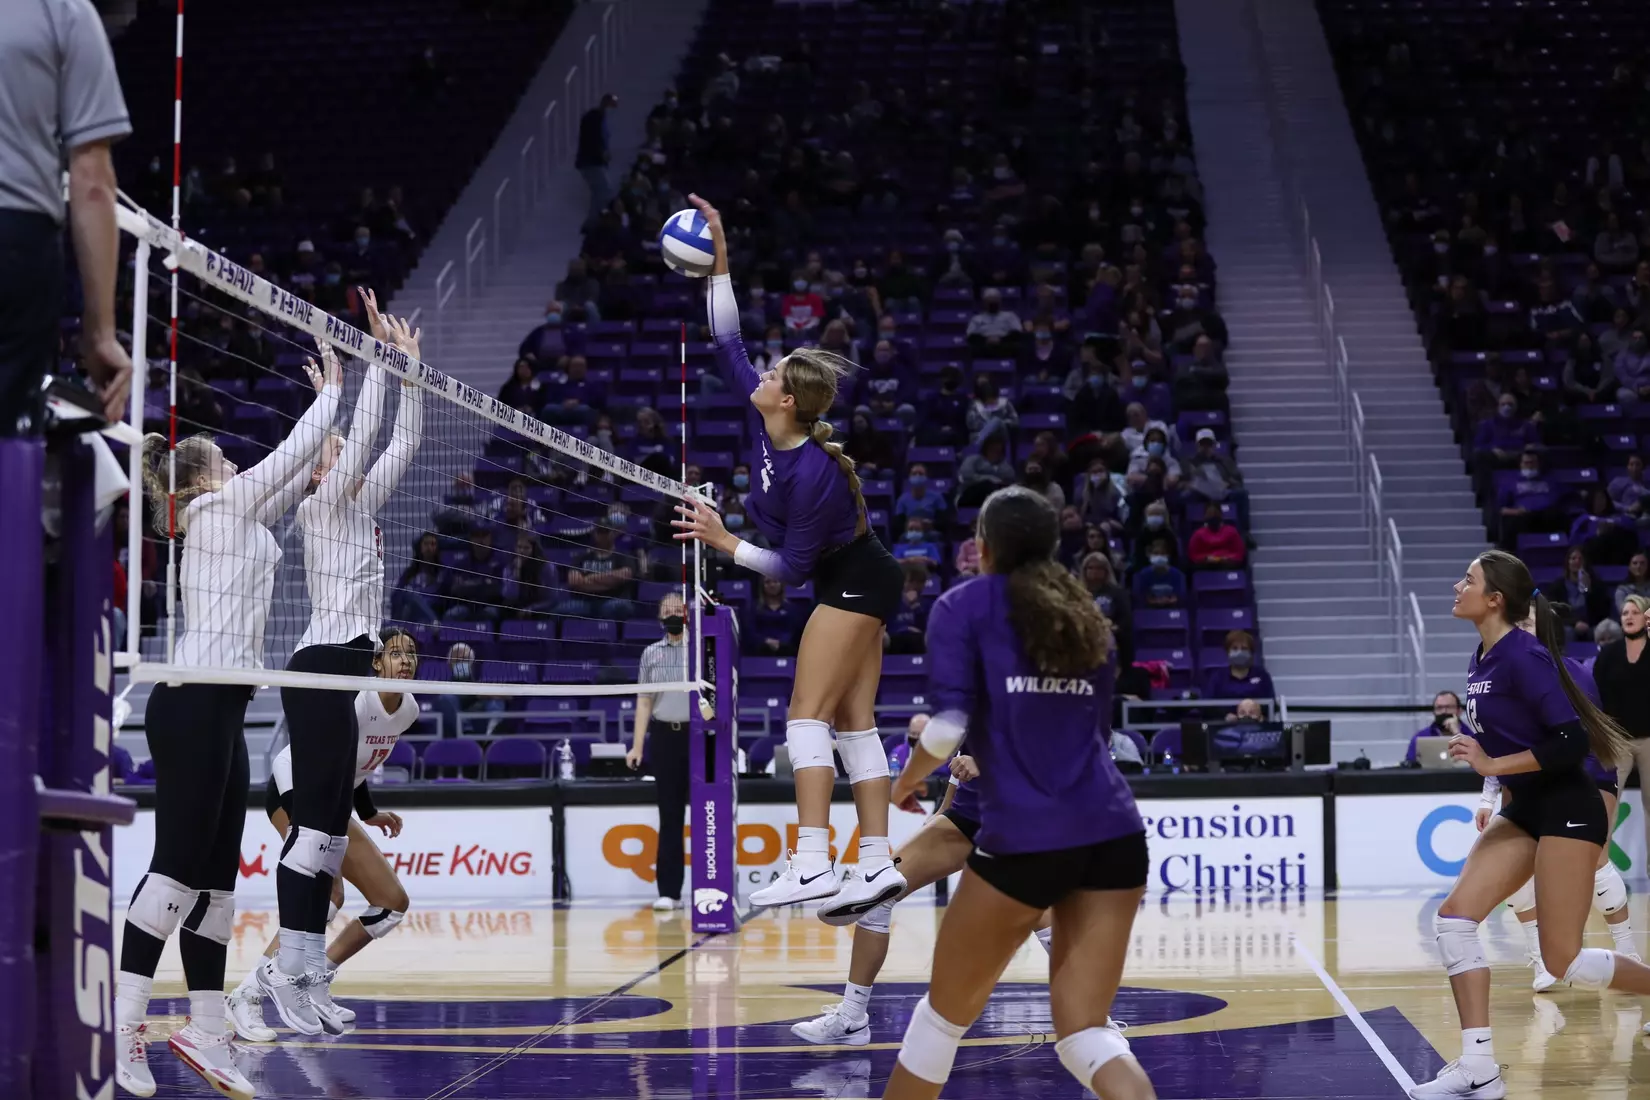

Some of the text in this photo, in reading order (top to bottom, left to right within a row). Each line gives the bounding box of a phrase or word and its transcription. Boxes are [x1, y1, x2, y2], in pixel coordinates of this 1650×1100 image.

[1006, 676, 1094, 696] WILDCATS
[1466, 698, 1485, 735] 12
[366, 735, 398, 745] TEXAS TE
[704, 800, 718, 880] sports imports
[1141, 804, 1296, 840] cension
[1159, 853, 1308, 889] Christi
